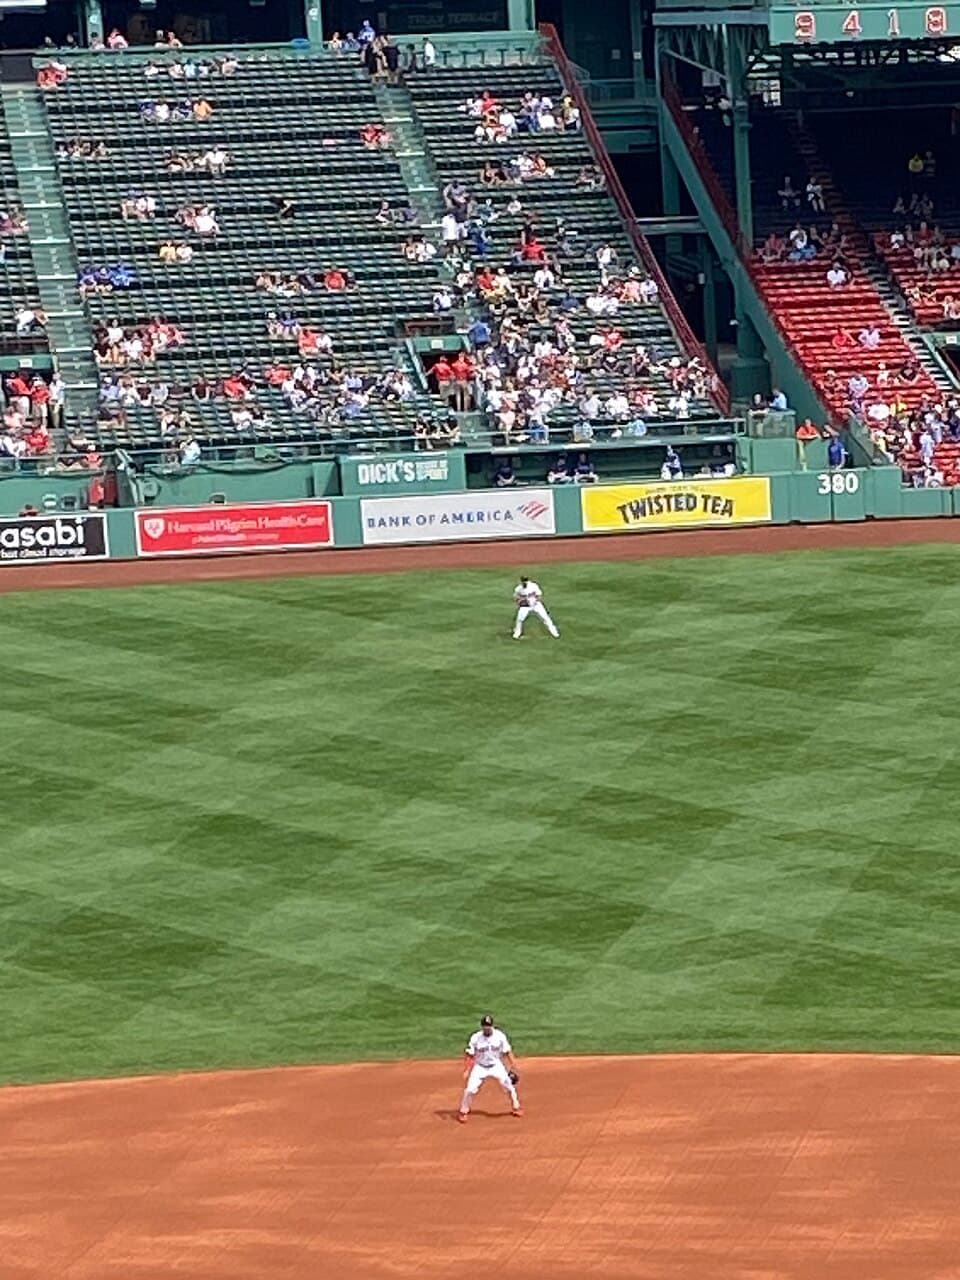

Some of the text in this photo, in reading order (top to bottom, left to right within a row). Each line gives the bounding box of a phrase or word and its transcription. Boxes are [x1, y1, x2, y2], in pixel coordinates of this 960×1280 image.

[795, 11, 815, 39] 9
[842, 10, 862, 38] 4
[887, 9, 899, 36] 1
[925, 7, 947, 34] 8
[357, 459, 416, 484] DICK'S
[817, 473, 859, 494] 380
[367, 510, 514, 528] BANK OF AMERICA
[617, 493, 736, 524] TWISTED TEA
[167, 519, 215, 534] Harvard
